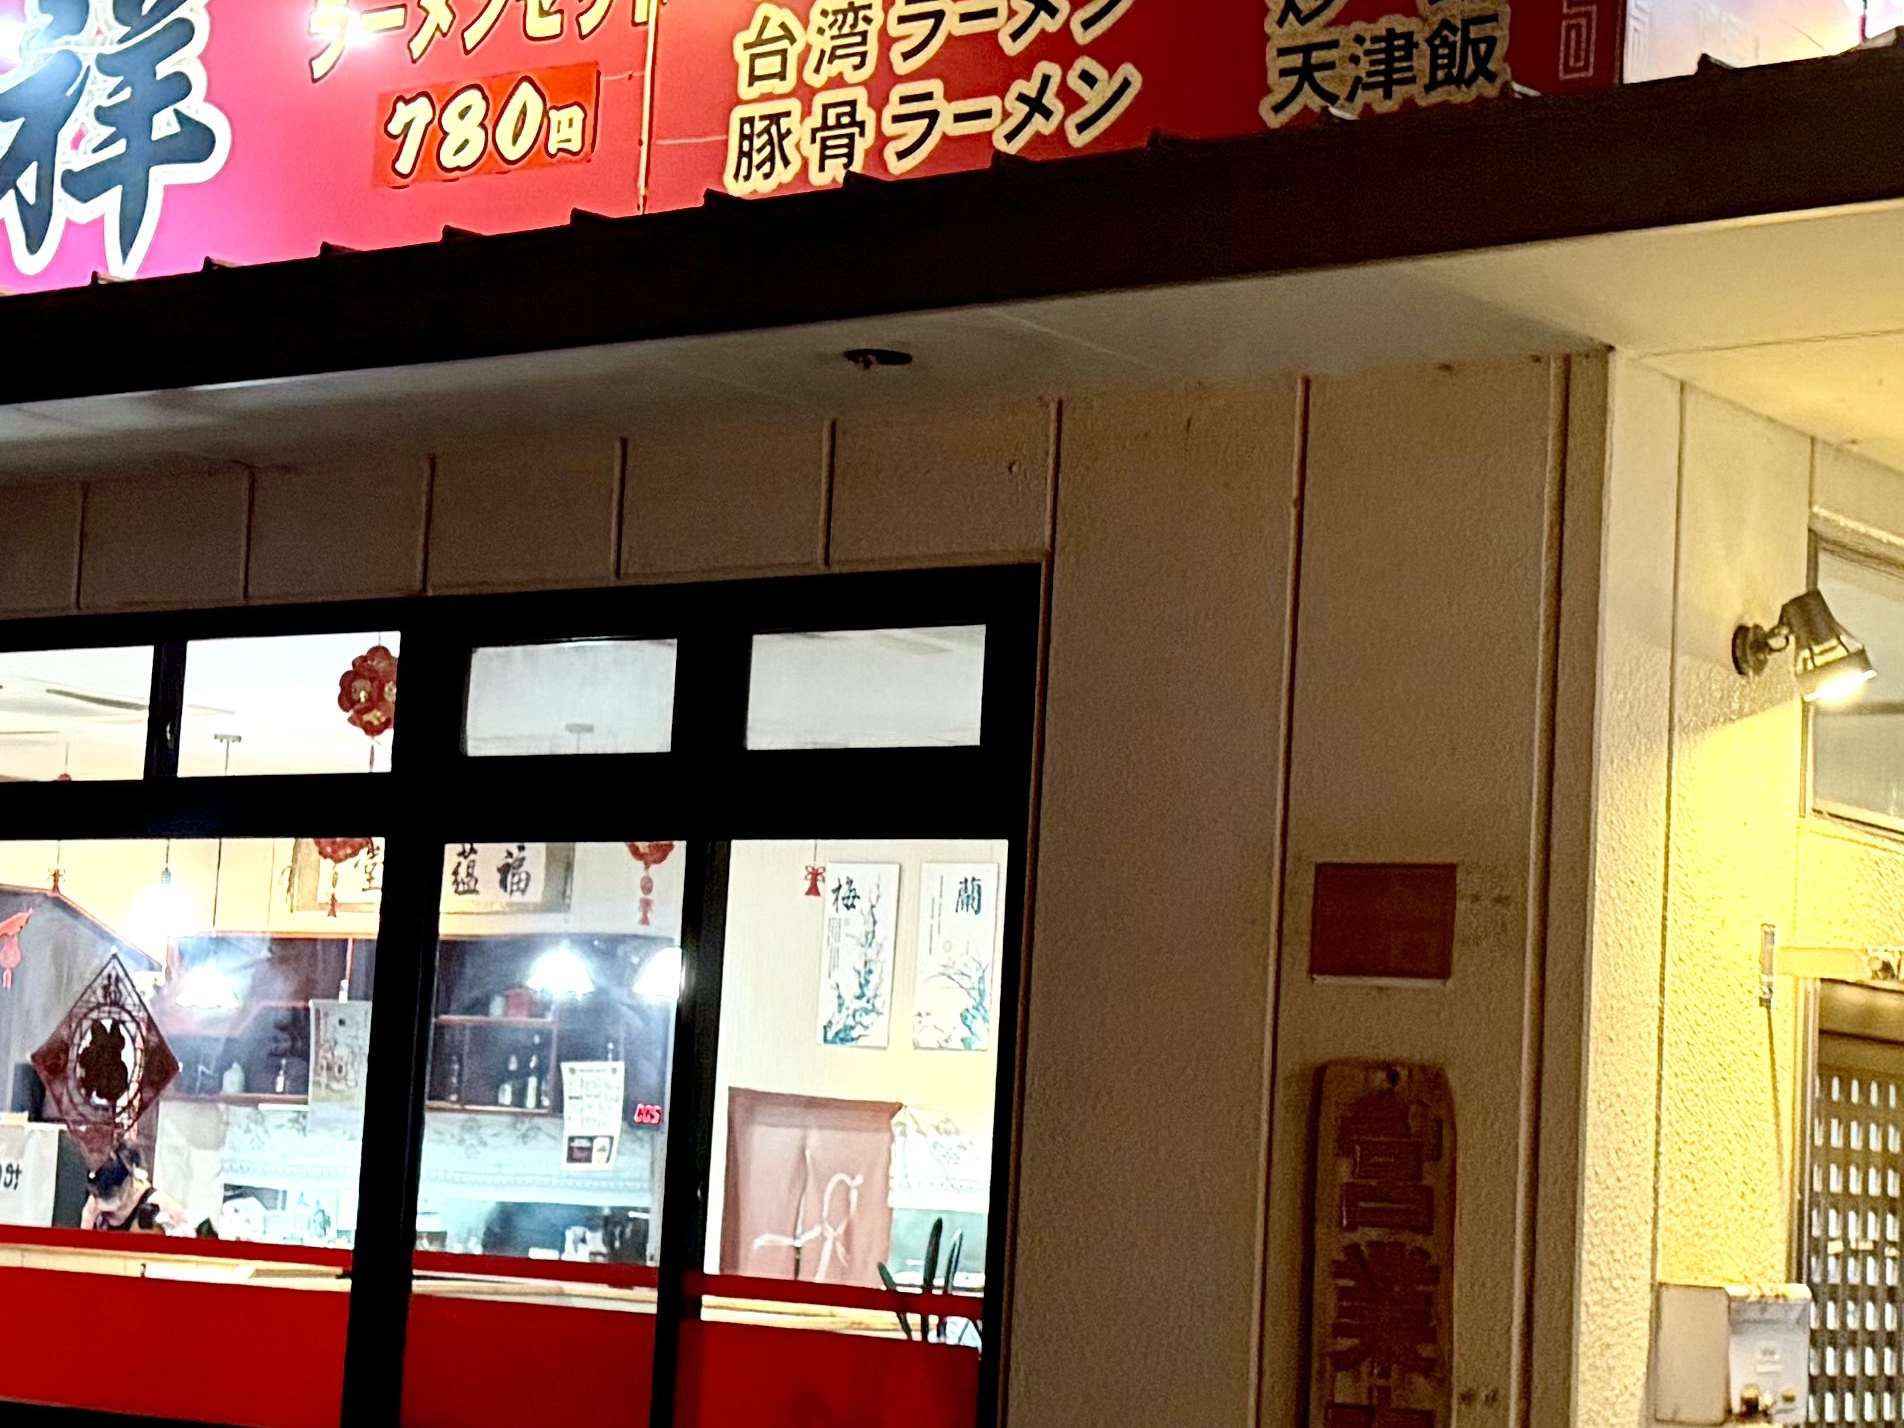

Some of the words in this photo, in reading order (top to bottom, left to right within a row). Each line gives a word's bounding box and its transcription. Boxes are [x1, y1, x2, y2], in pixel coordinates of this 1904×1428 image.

[1262, 17, 1505, 126] 天津飯
[385, 75, 587, 178] 780円
[727, 61, 1142, 194] 豚骨ラーメン
